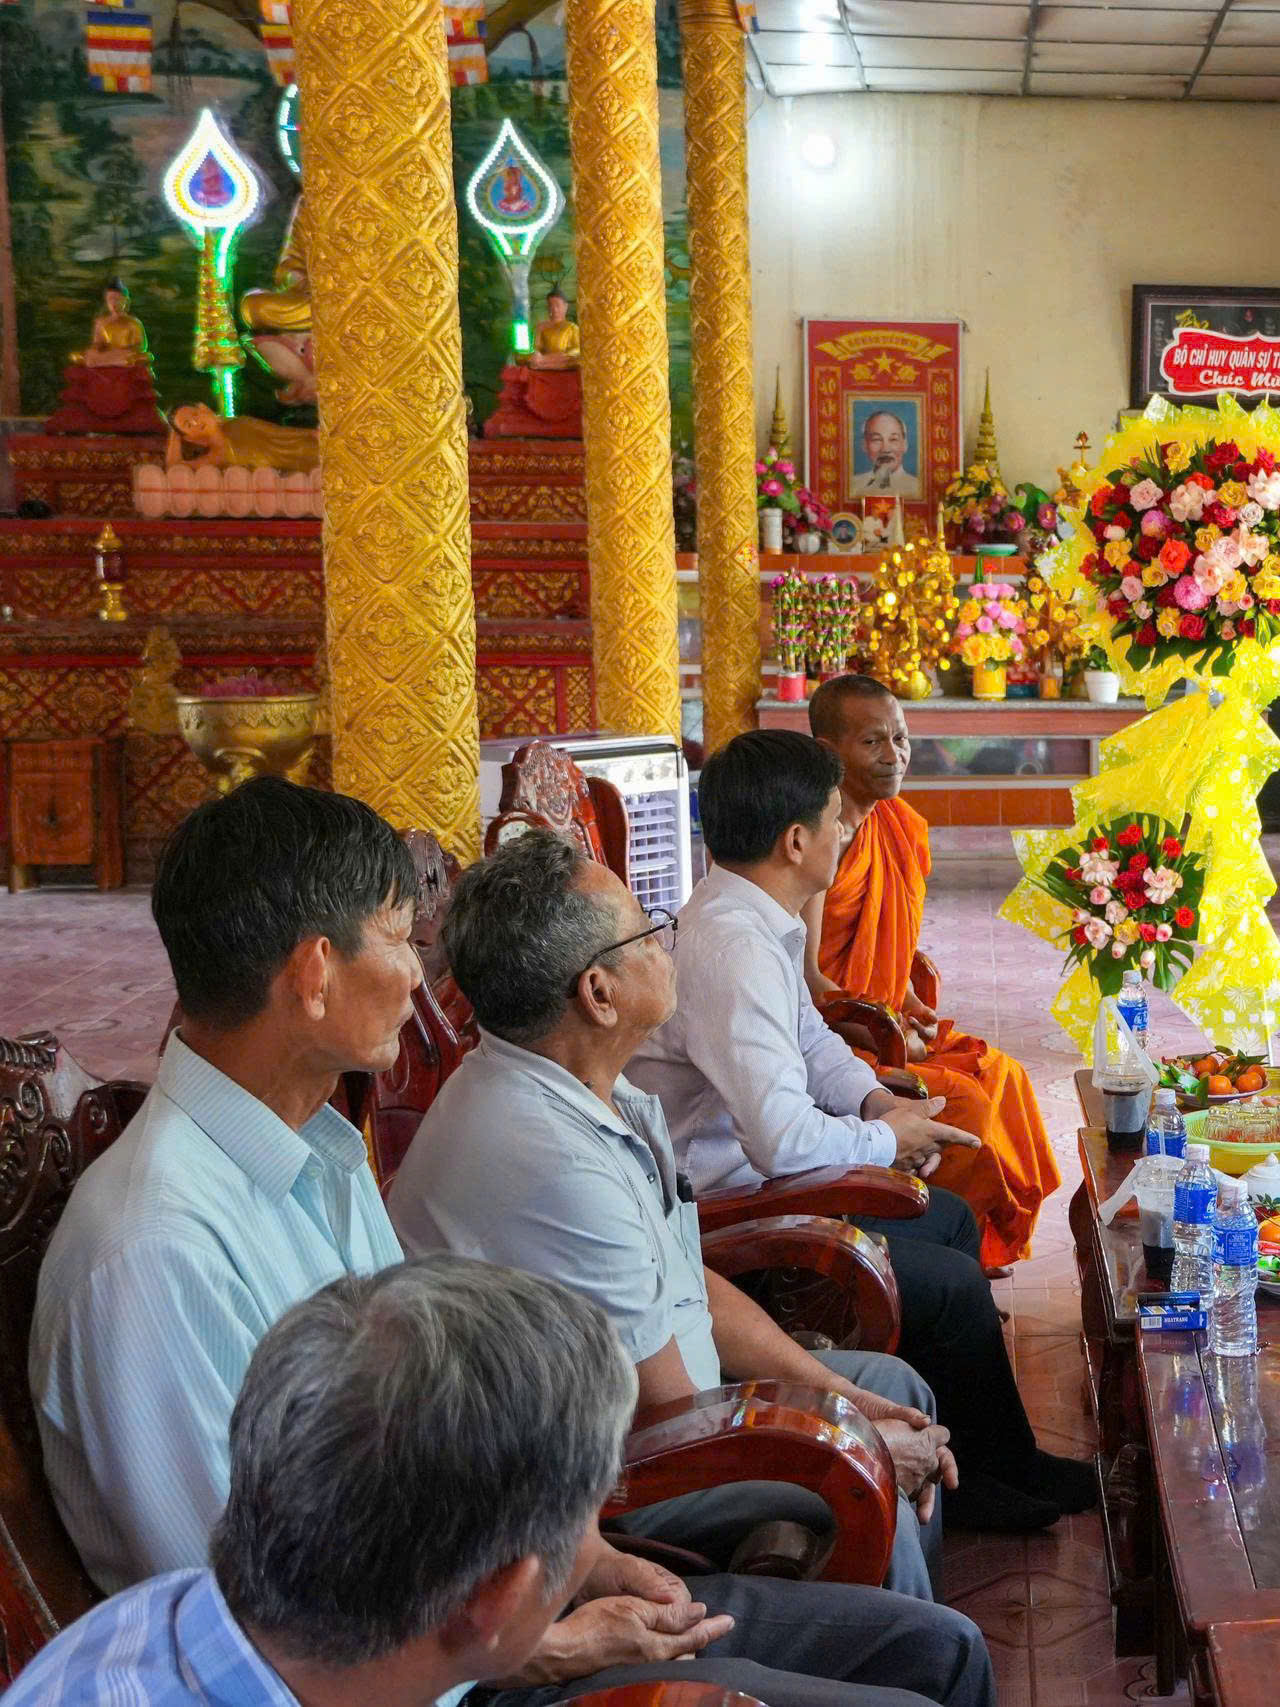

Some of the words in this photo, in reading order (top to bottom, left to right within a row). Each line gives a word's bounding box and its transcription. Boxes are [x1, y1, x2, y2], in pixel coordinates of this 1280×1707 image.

[1173, 345, 1188, 367] BỘ
[1189, 344, 1208, 366] CHỈ
[1208, 349, 1229, 367] HUY
[1229, 347, 1256, 369] QUÂN
[1257, 351, 1272, 373] SỰ
[1199, 369, 1246, 386] Chúc
